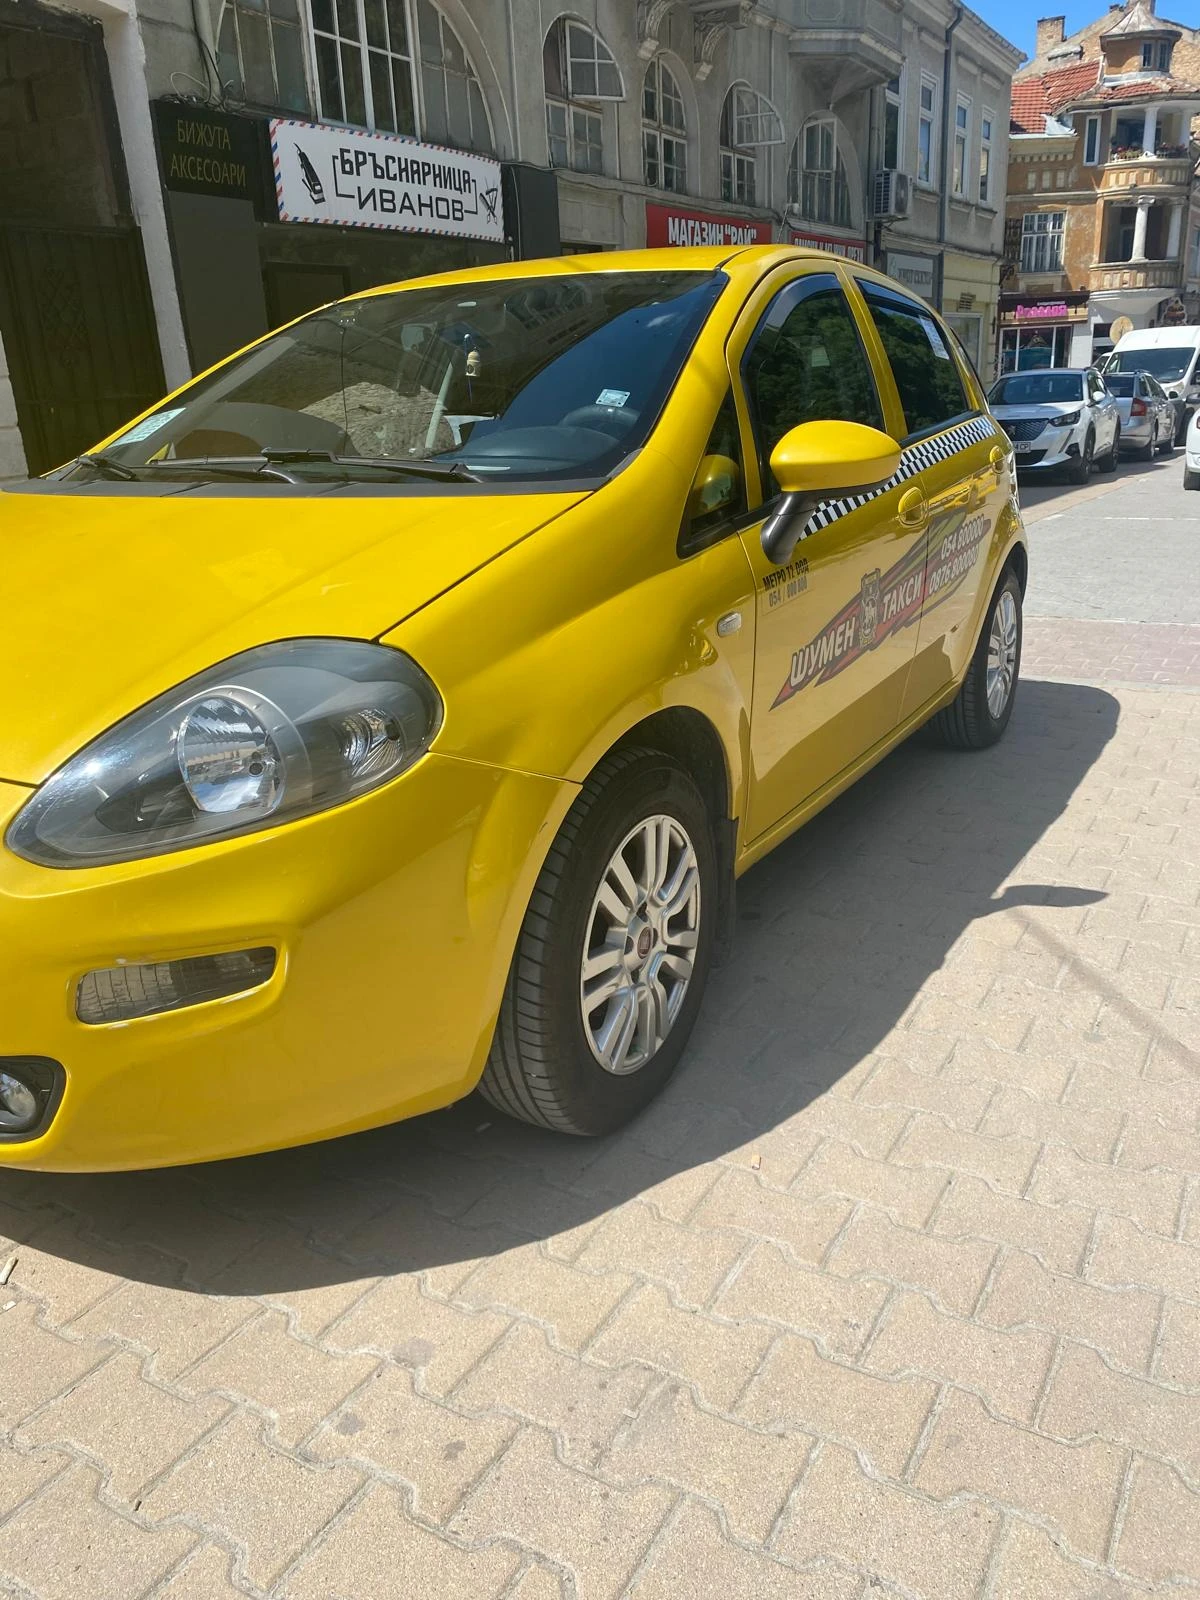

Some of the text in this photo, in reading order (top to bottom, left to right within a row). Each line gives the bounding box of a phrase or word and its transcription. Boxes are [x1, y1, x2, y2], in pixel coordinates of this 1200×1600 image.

[176, 119, 231, 150] БИЖУТА
[170, 156, 247, 188] АКСЕСОАРИ
[339, 147, 472, 195] БРЪСНАРНИЦА
[357, 186, 464, 222] ИВАНОВ
[668, 216, 724, 246] МАГАЗИН
[762, 569, 786, 592] МЕТРО
[881, 573, 923, 623] ТАКСИ
[790, 617, 856, 687] ШУМЕН
